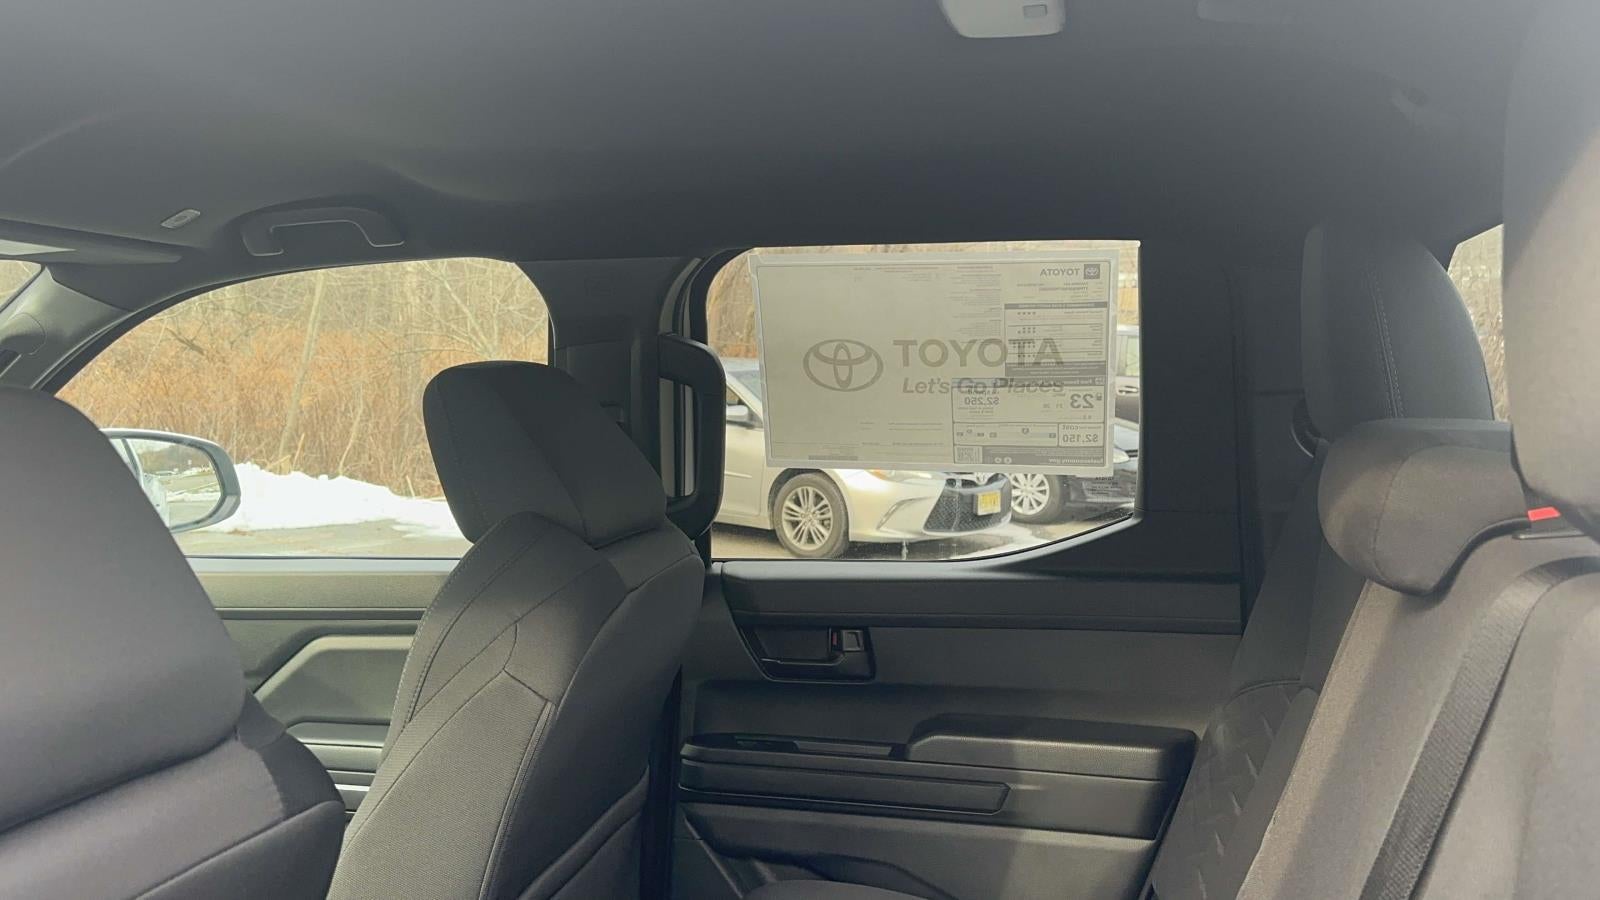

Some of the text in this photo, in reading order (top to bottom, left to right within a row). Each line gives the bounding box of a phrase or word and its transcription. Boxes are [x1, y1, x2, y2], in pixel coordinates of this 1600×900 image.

[893, 337, 1064, 368] TOYOTA
[903, 377, 950, 394] Let's
[957, 377, 987, 395] Go
[993, 377, 1065, 395] Places
